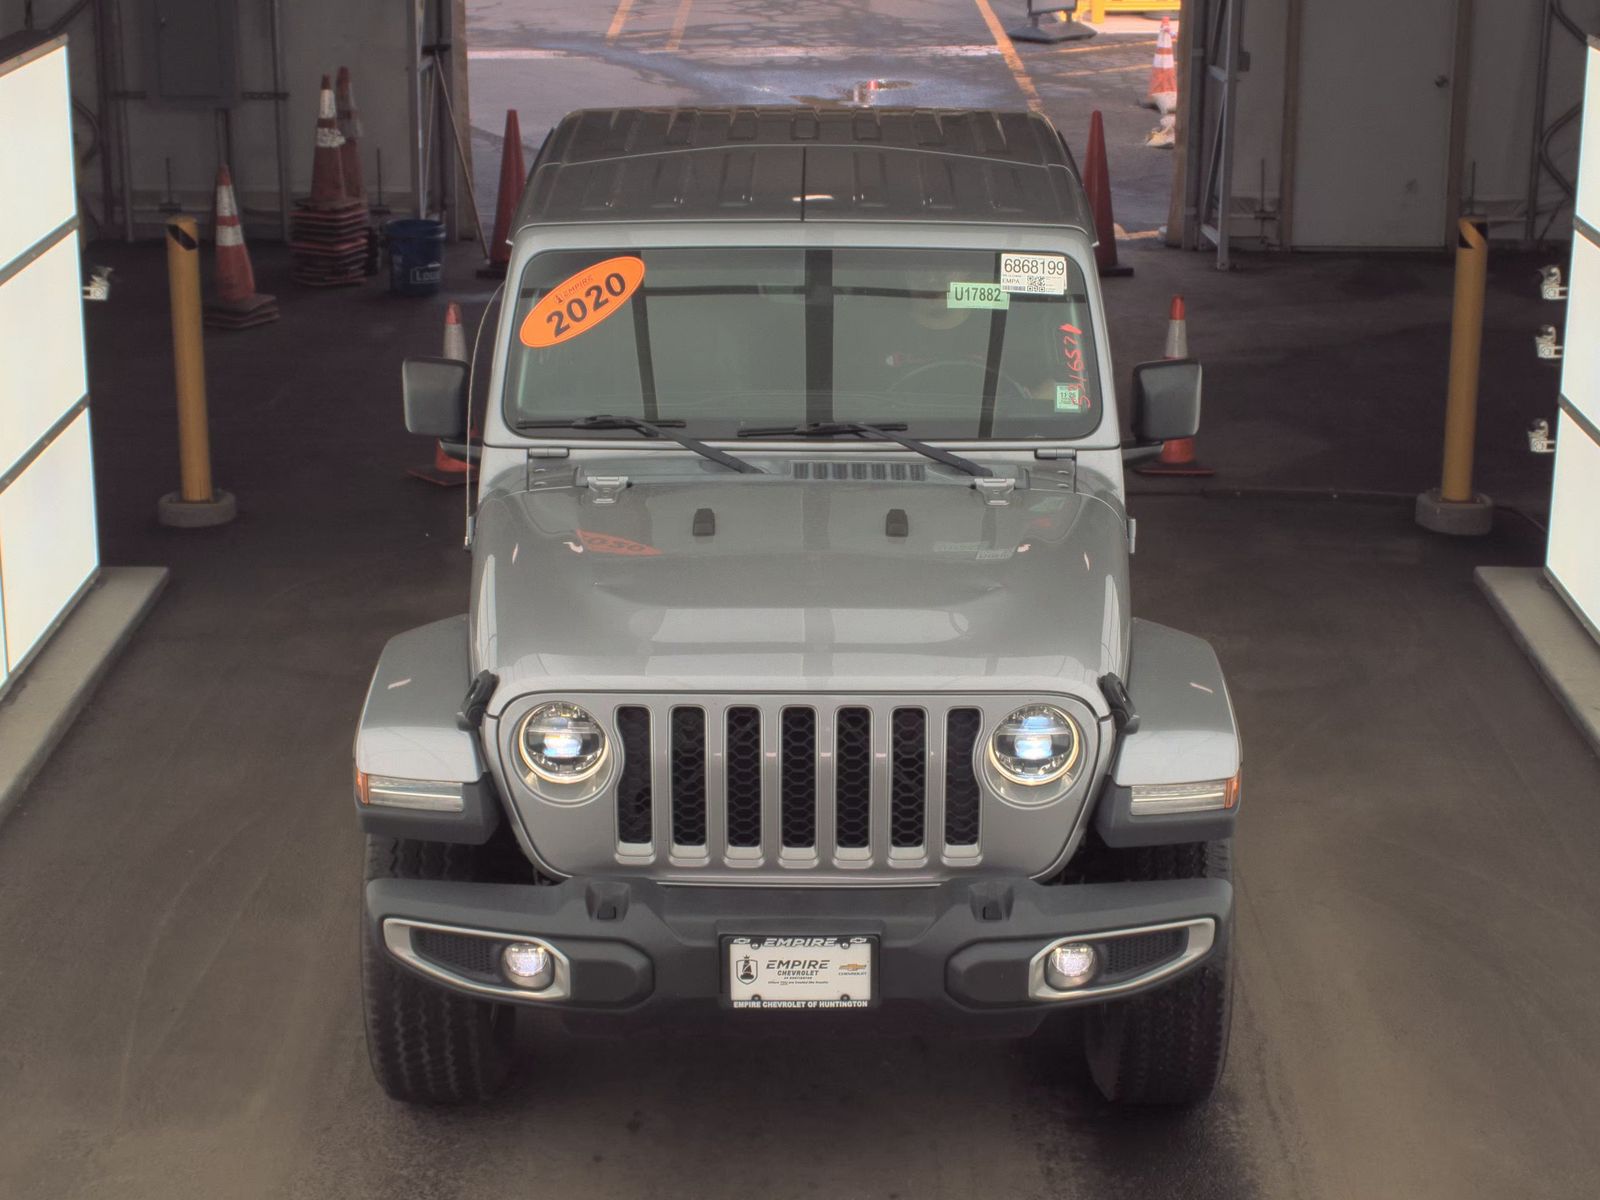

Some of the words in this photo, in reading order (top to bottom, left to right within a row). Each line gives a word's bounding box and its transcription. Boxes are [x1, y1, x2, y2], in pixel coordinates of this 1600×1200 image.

[1004, 258, 1065, 276] 6868199
[954, 286, 1001, 301] U17882
[545, 272, 626, 338] 2020
[764, 937, 838, 948] EMPIRE
[766, 959, 830, 970] EMPIRE
[733, 1000, 762, 1009] EMPIRE
[762, 1000, 805, 1009] CHEVROLET
[807, 1000, 817, 1008] OF
[819, 1000, 868, 1008] HUNTINGTON
